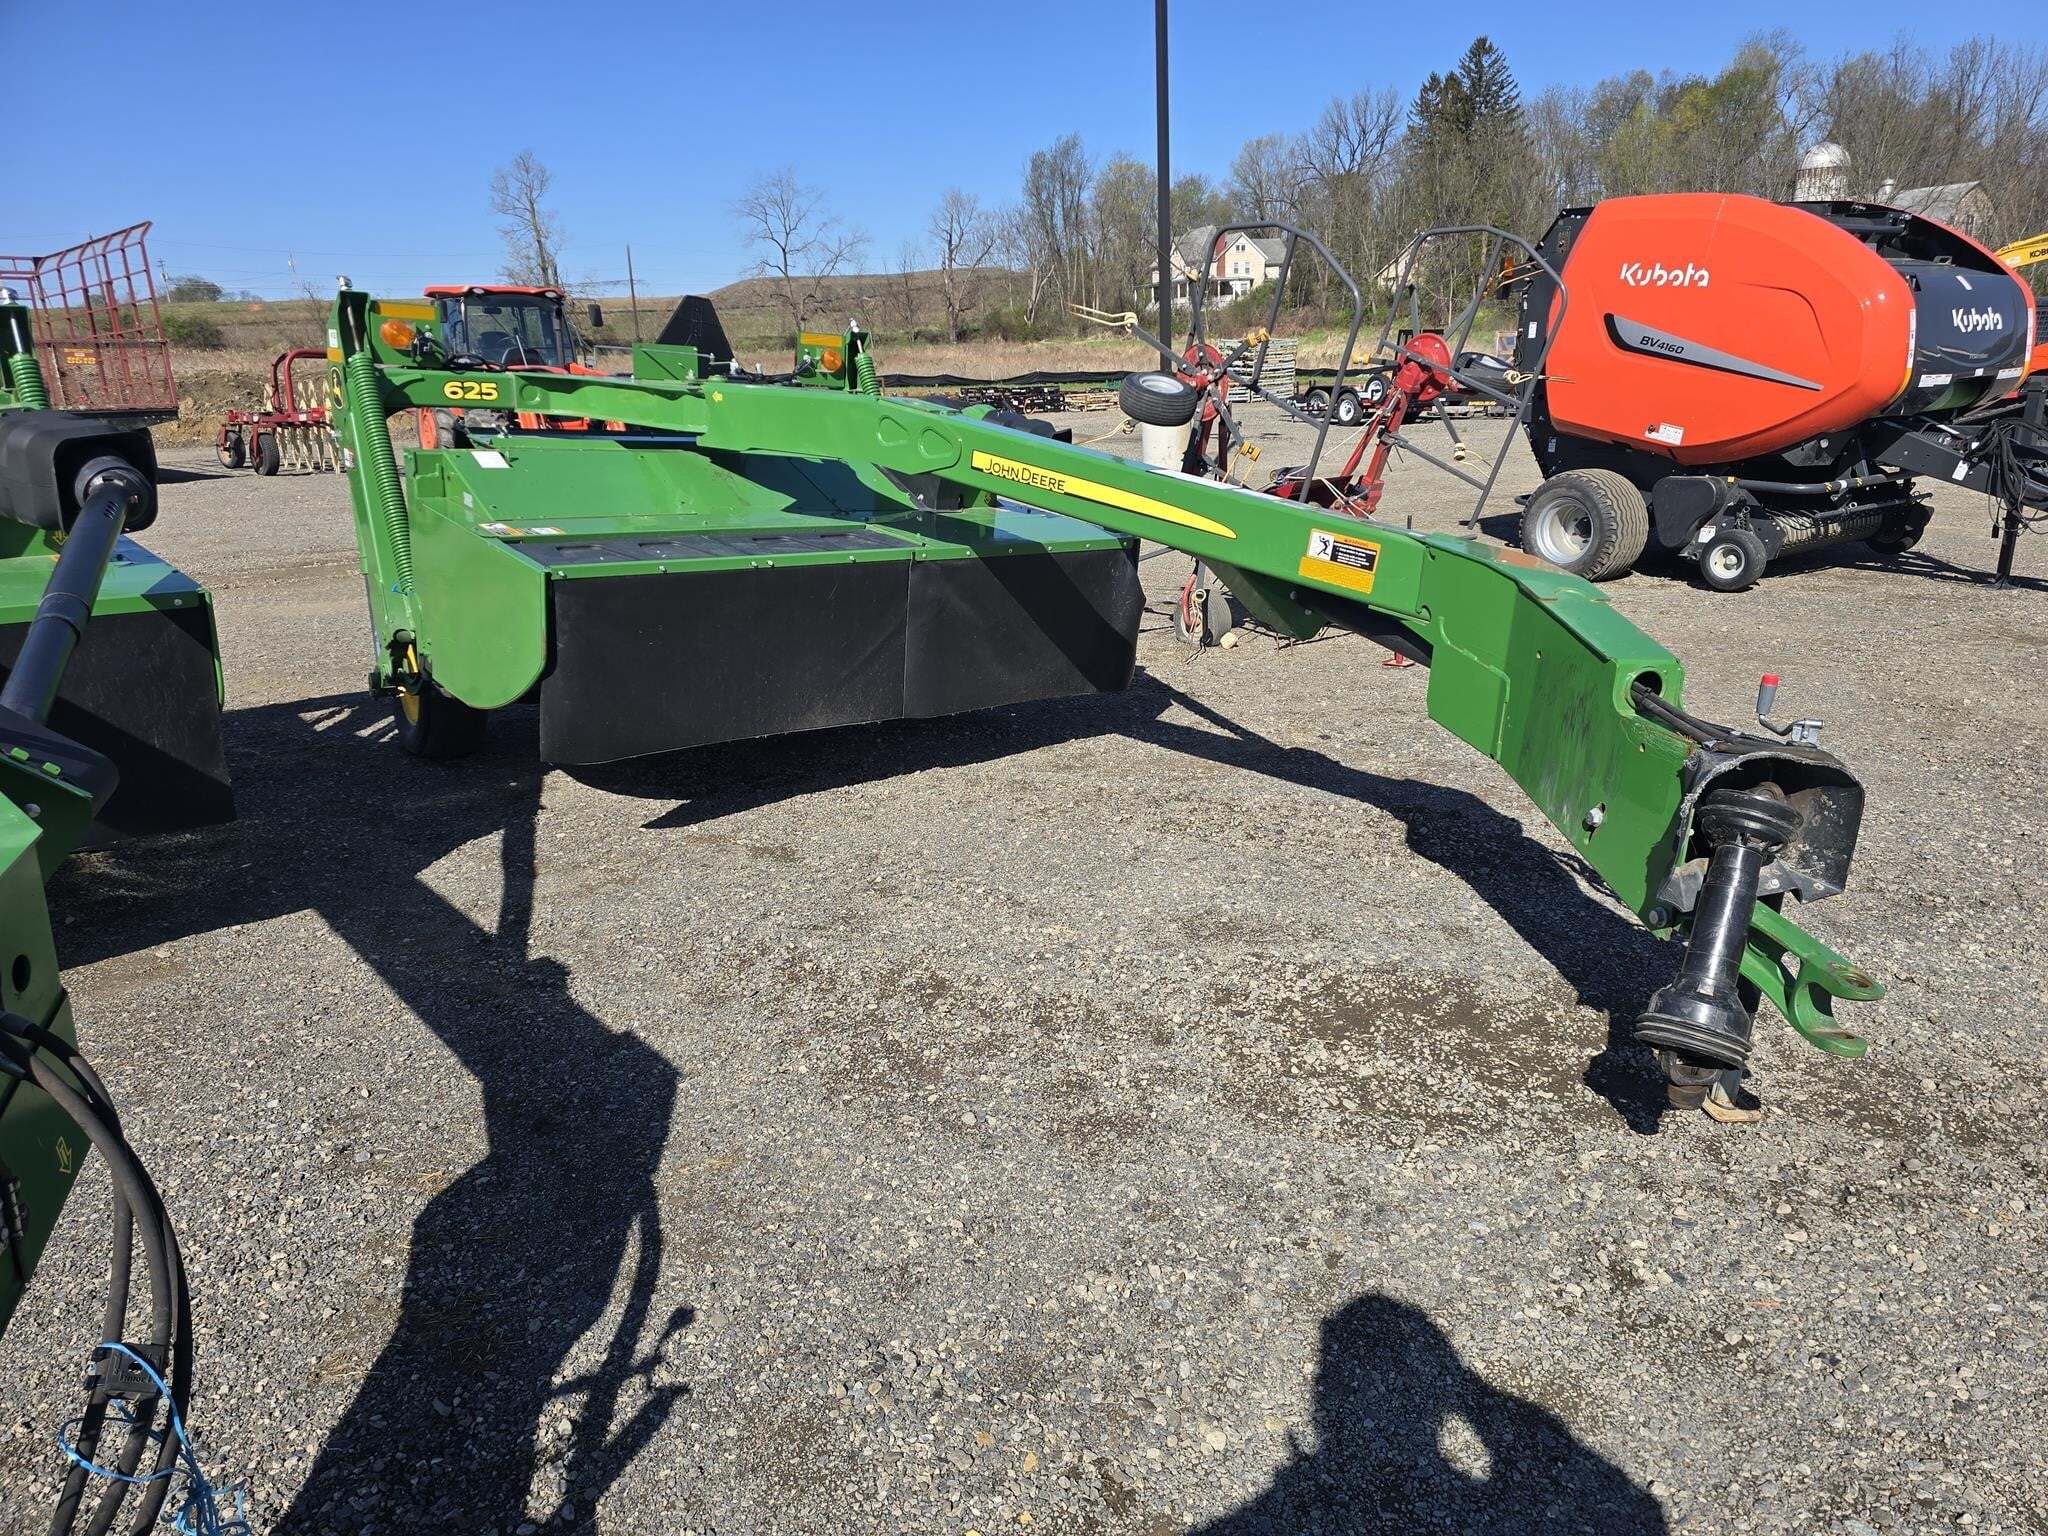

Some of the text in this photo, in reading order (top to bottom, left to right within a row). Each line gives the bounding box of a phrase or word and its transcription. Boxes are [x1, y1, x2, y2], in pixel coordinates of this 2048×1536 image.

[2030, 247, 2048, 259] KOB
[1619, 261, 1711, 288] Kubota
[1951, 305, 2004, 333] Kubota
[1639, 335, 1685, 355] BV4160
[443, 380, 499, 400] 625
[985, 457, 1066, 492] JOHN DEERE
